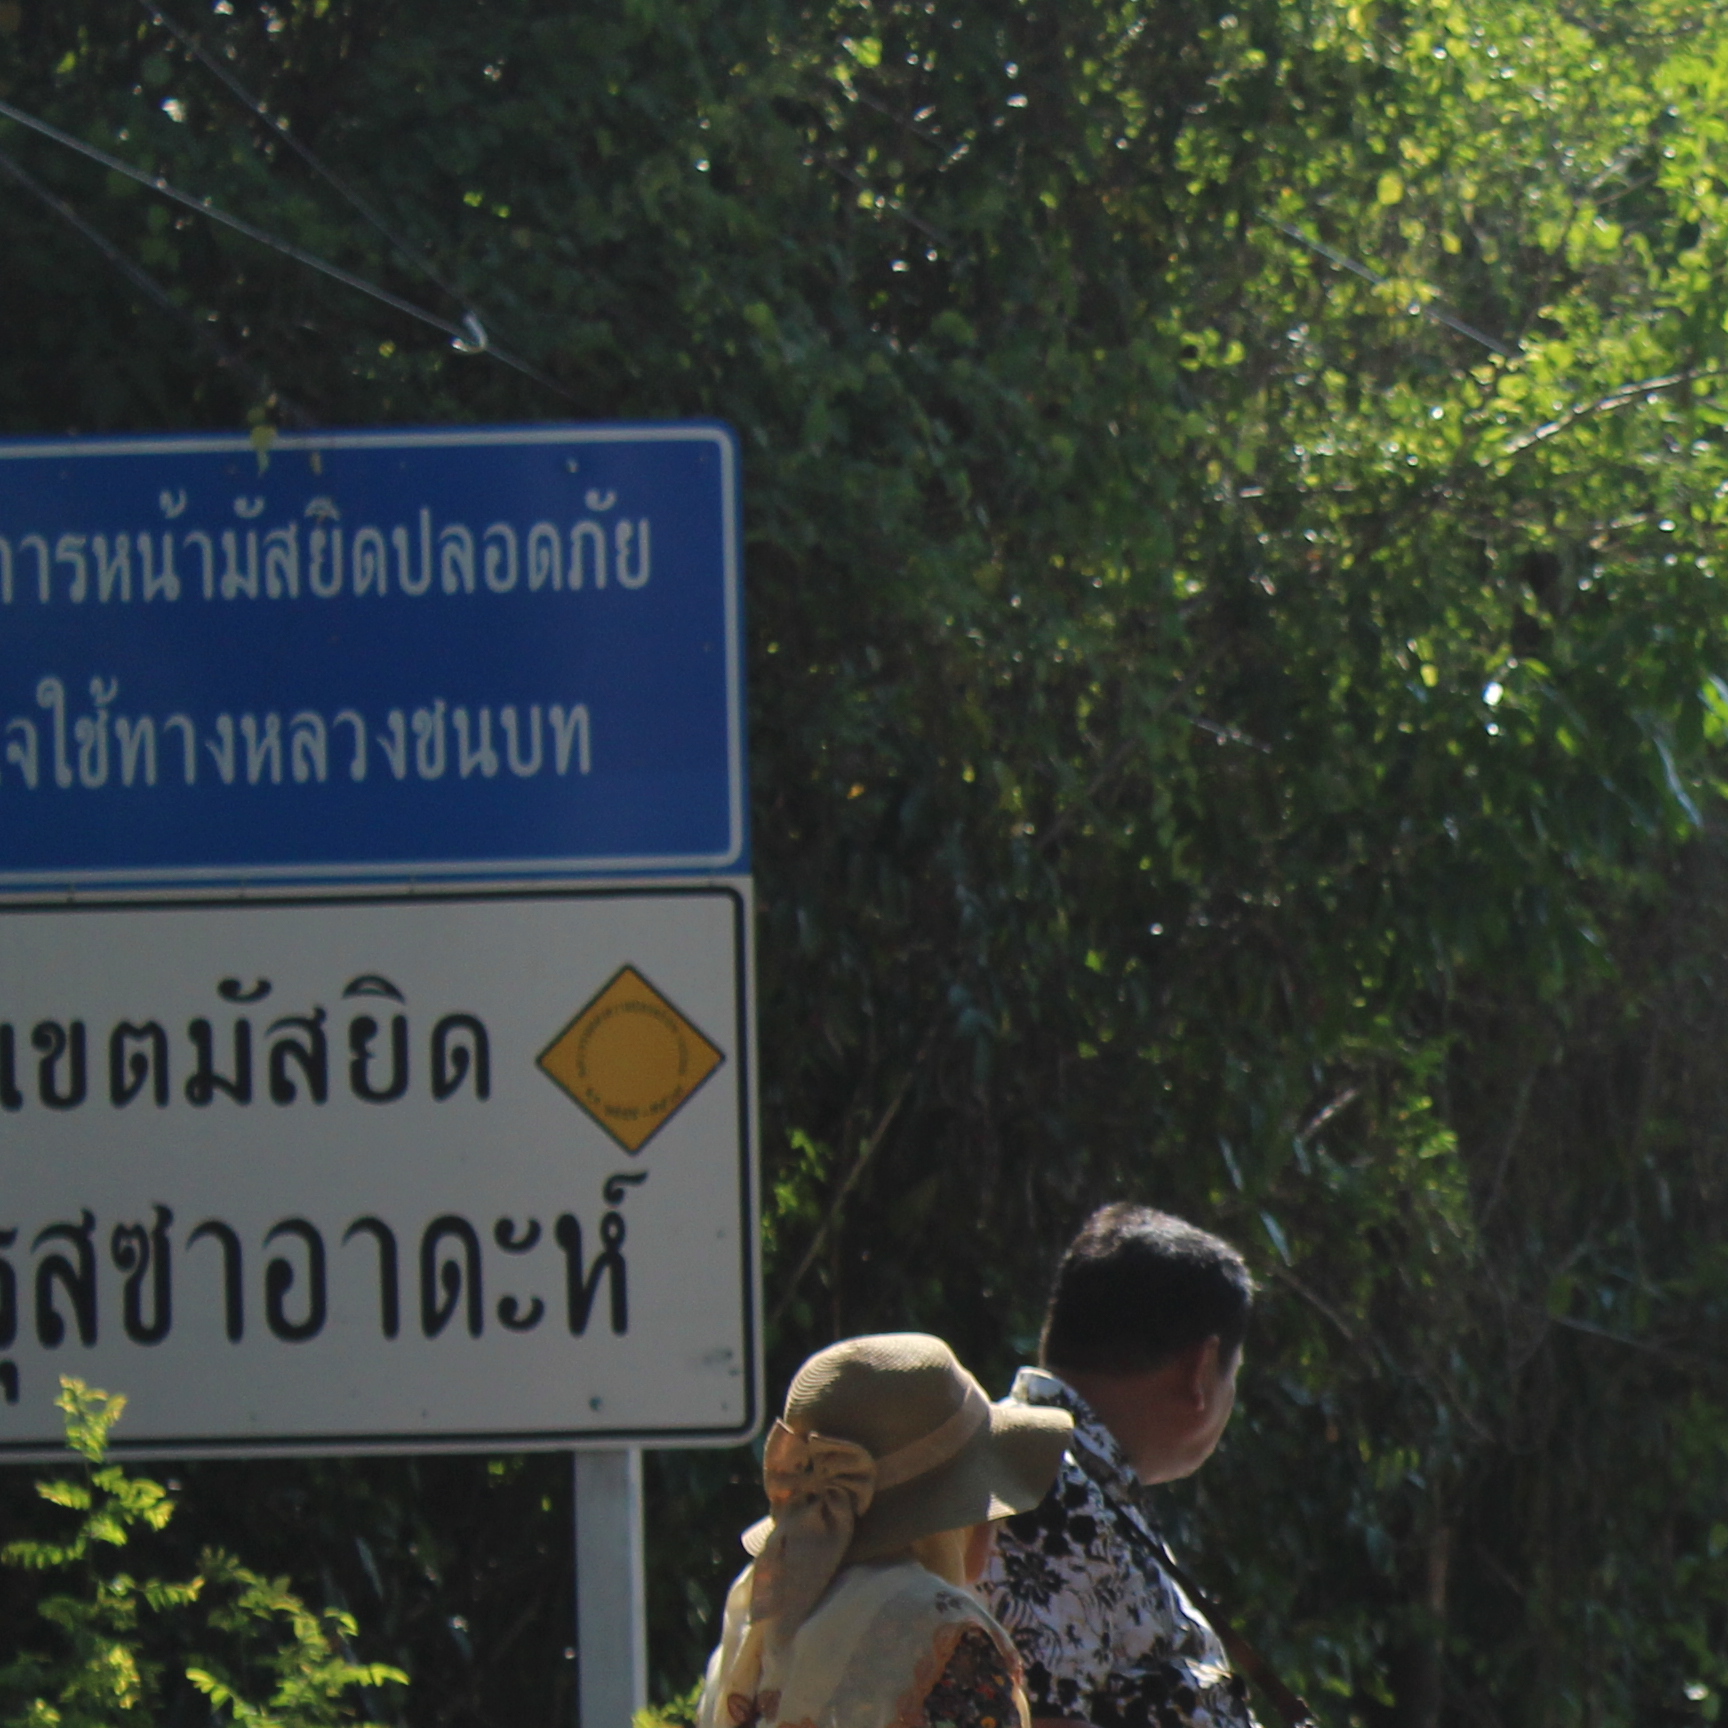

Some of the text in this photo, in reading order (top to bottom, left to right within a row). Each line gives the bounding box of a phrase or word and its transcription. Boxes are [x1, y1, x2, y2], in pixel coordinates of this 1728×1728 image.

[5, 675, 592, 790] จใช้ทางหลวงชนบท
